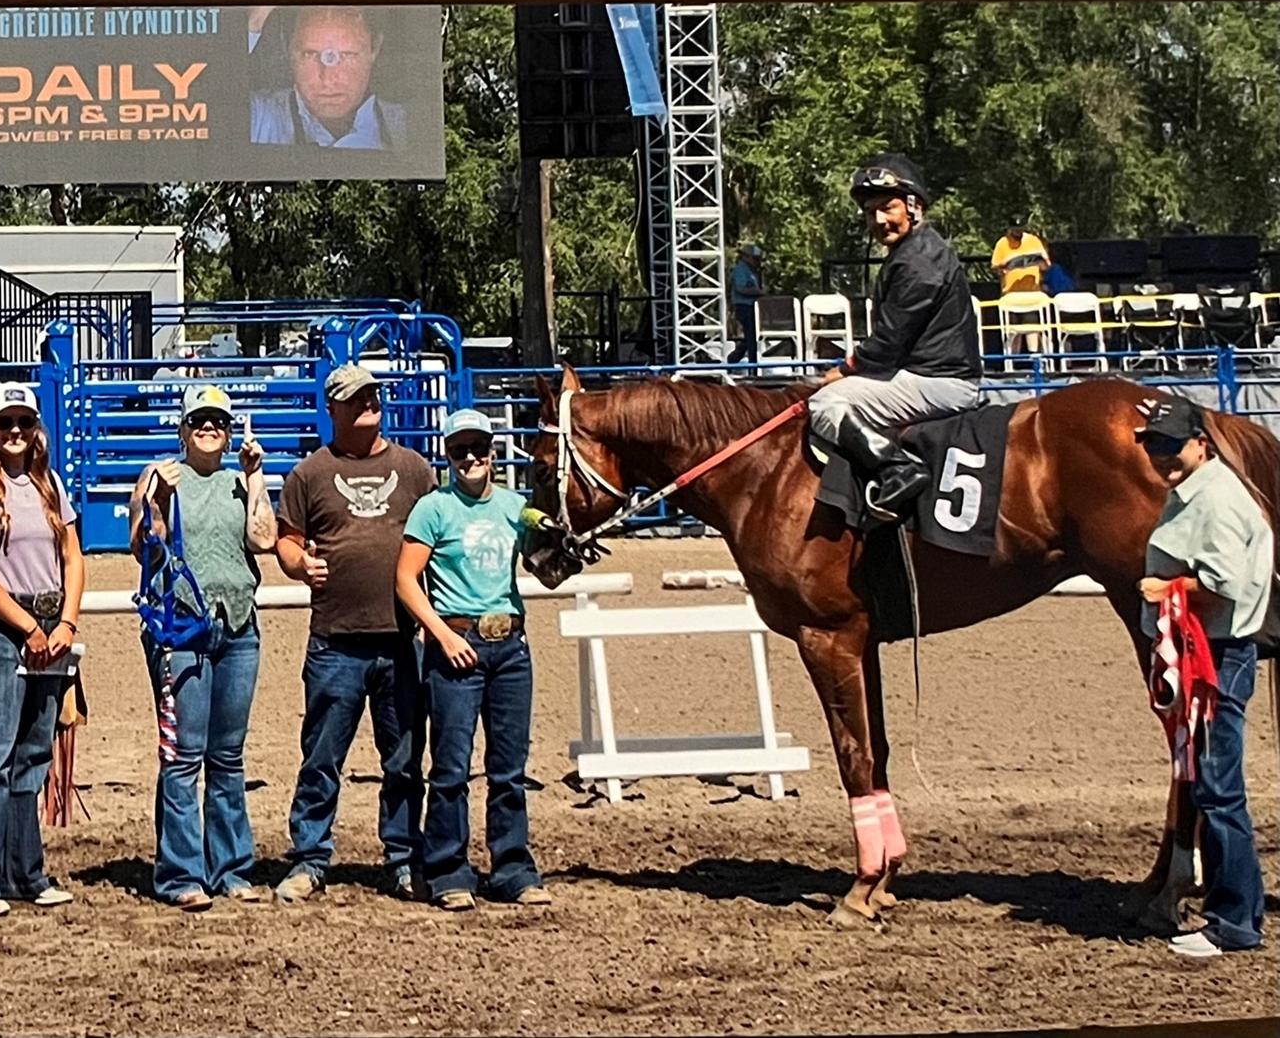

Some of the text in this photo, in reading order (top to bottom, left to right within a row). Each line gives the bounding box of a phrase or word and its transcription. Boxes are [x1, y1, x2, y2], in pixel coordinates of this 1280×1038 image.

[104, 8, 220, 36] HYPNOTIST
[79, 104, 108, 124] &
[118, 102, 207, 123] 9PM
[78, 129, 133, 141] FREE
[138, 127, 209, 141] STAGE
[933, 447, 987, 533] 5
